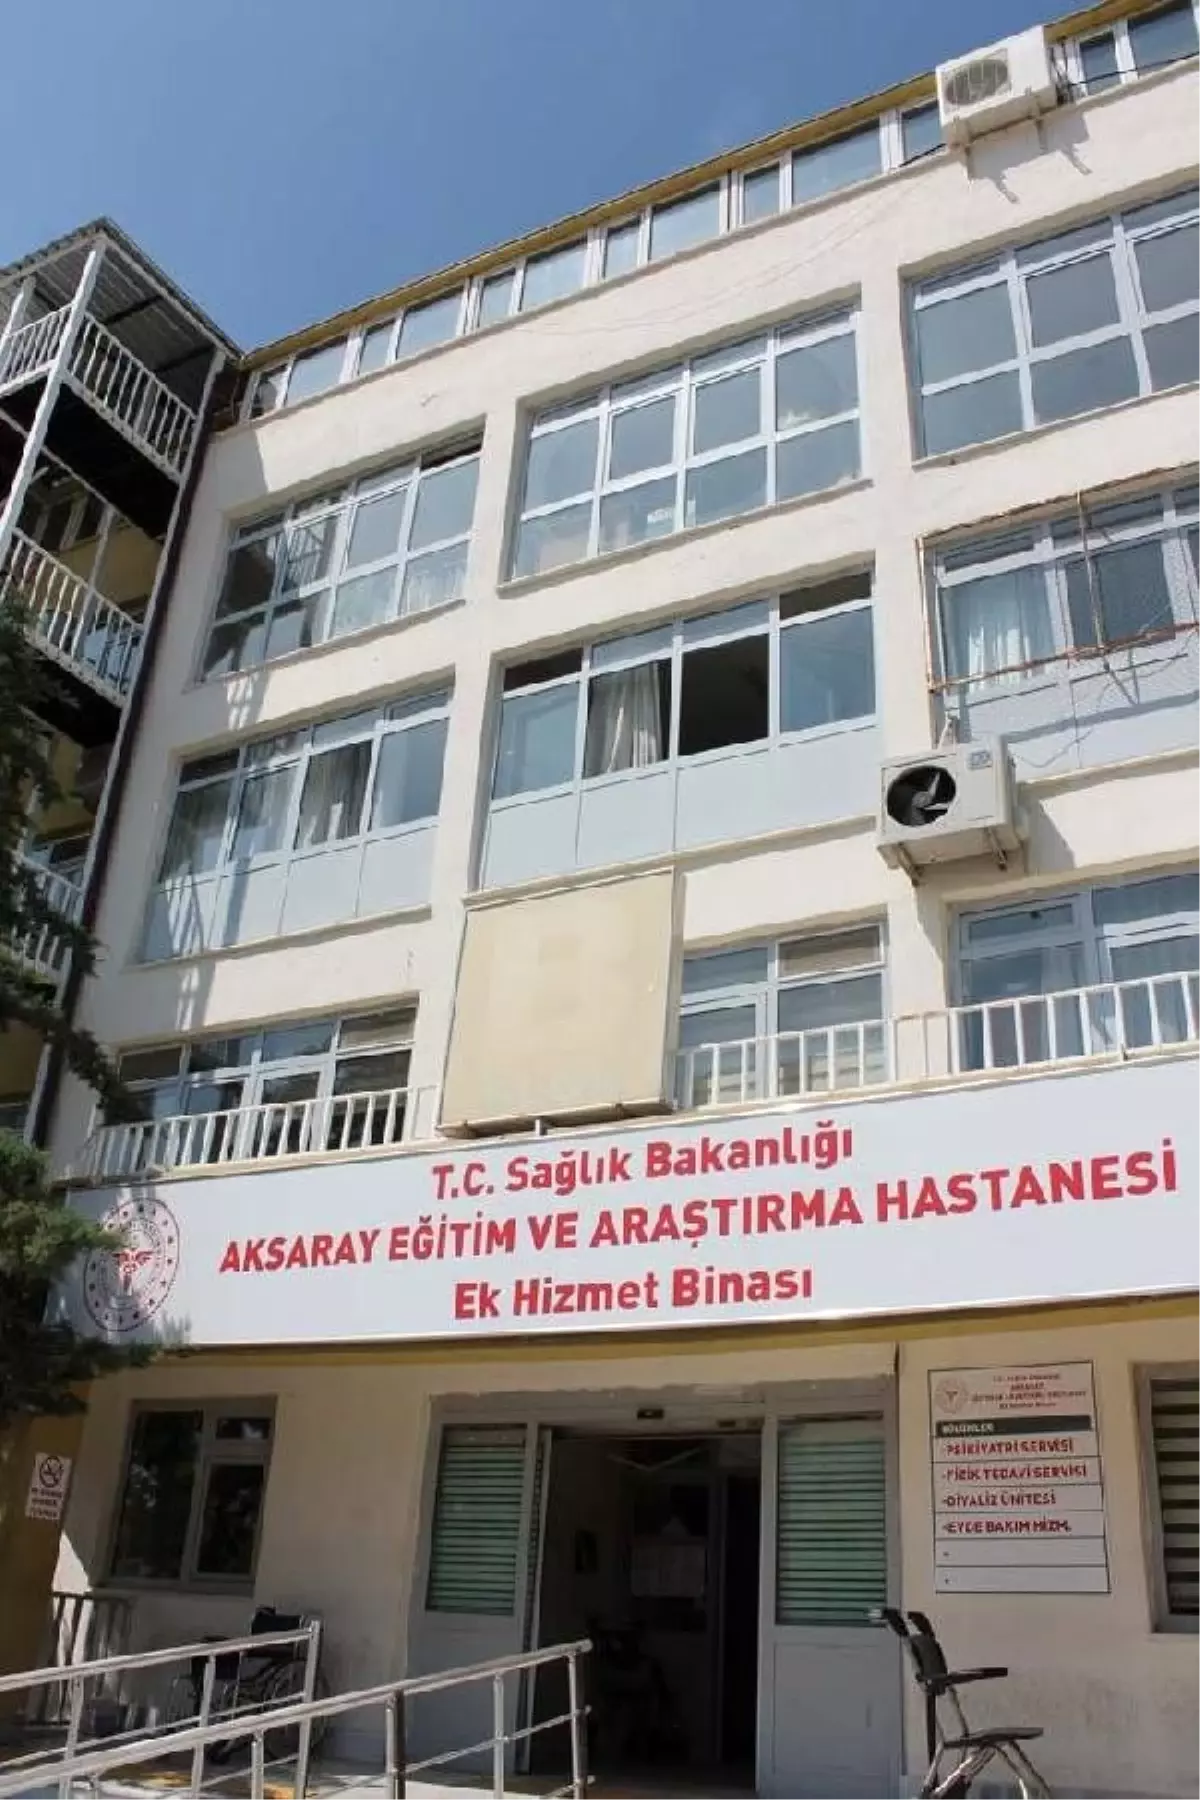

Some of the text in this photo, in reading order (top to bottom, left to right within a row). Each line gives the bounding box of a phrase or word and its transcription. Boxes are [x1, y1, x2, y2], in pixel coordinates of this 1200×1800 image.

[431, 1120, 853, 1199] T.C. Sağlık Bakanlığı
[219, 1229, 379, 1273] AKSARAY
[388, 1212, 518, 1261] EĞİTİM
[527, 1211, 578, 1251] VE
[589, 1186, 864, 1249] ARAŞTIRMA
[876, 1137, 1178, 1223] HASTANESİ
[455, 1265, 813, 1320] Ek Hizmet Binası
